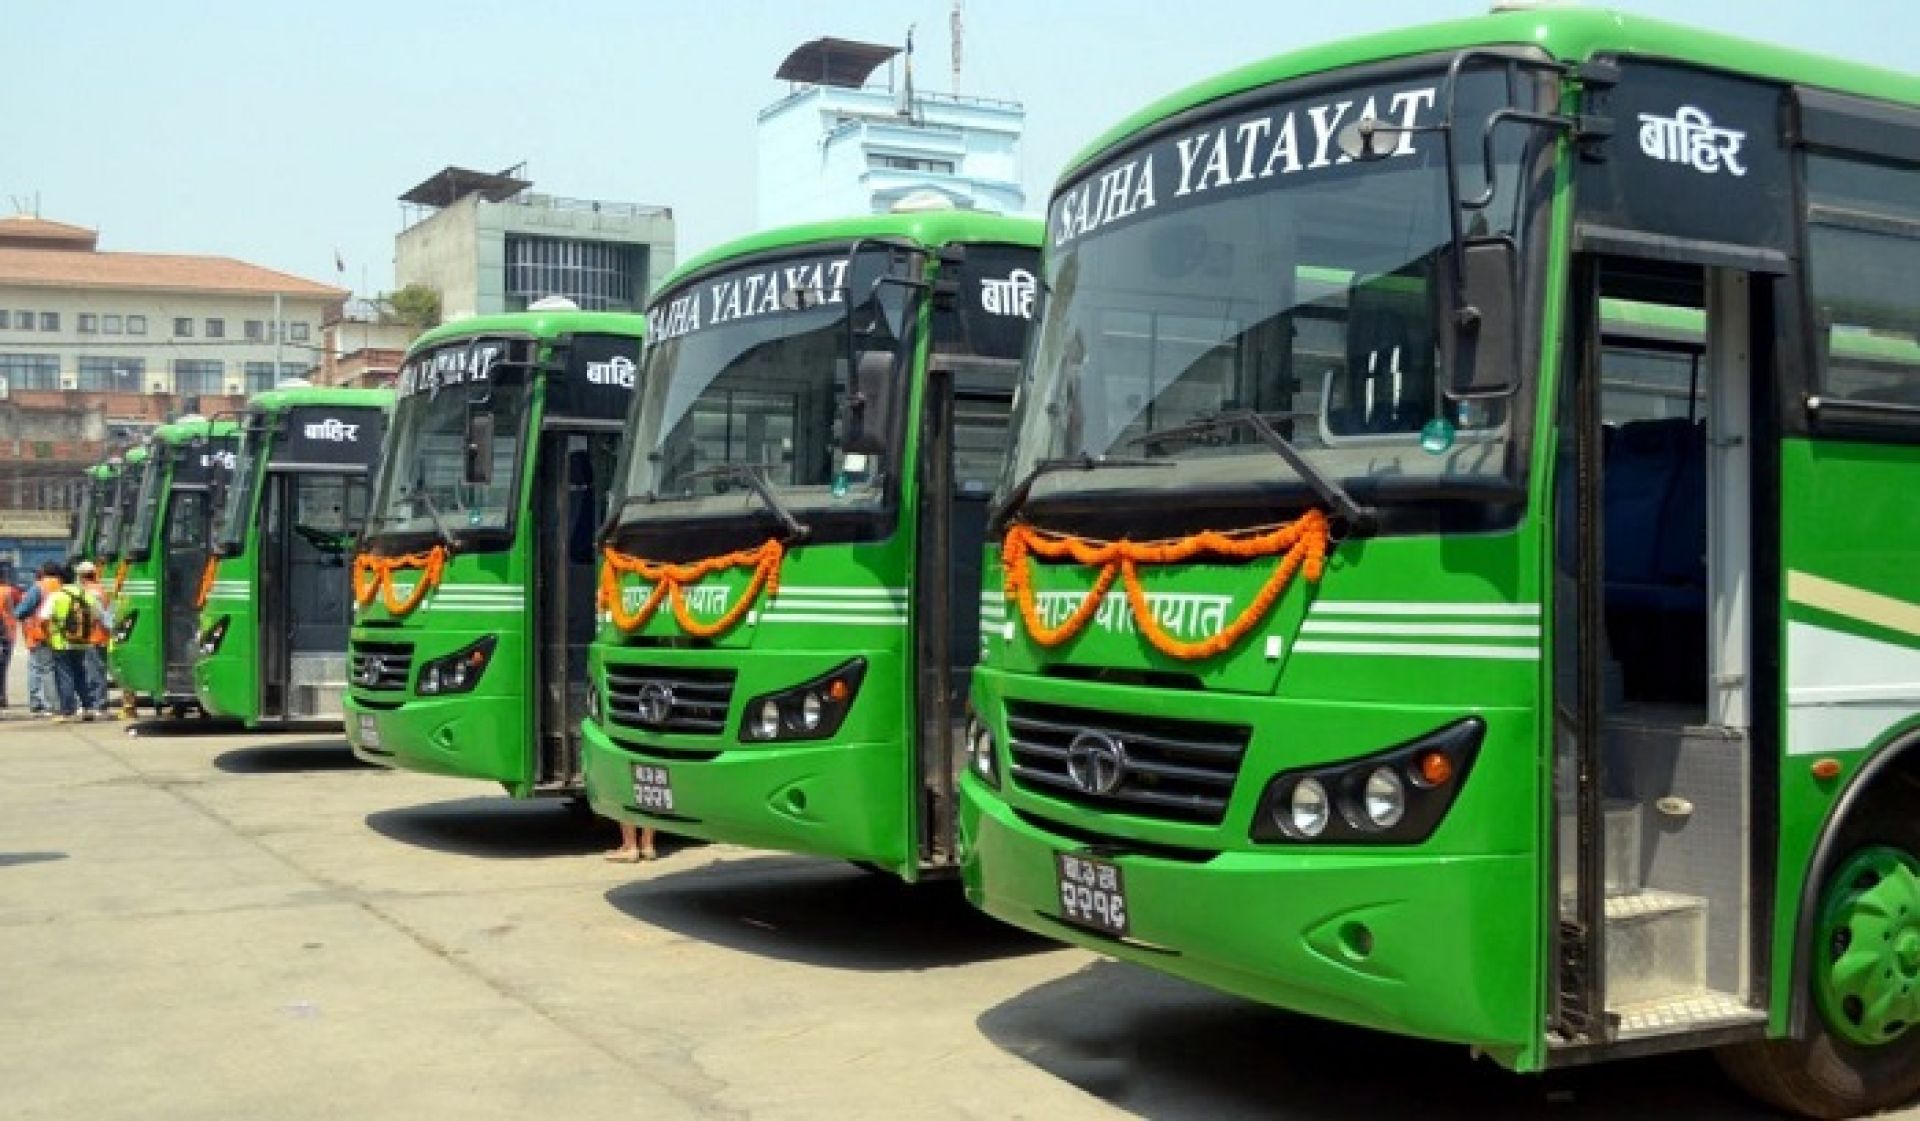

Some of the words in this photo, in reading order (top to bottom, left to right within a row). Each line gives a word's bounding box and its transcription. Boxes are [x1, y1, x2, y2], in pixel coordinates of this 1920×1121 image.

[1637, 105, 1747, 176] बाहिर
[1055, 153, 1156, 246] SAJHA
[981, 268, 1036, 319] बाहि
